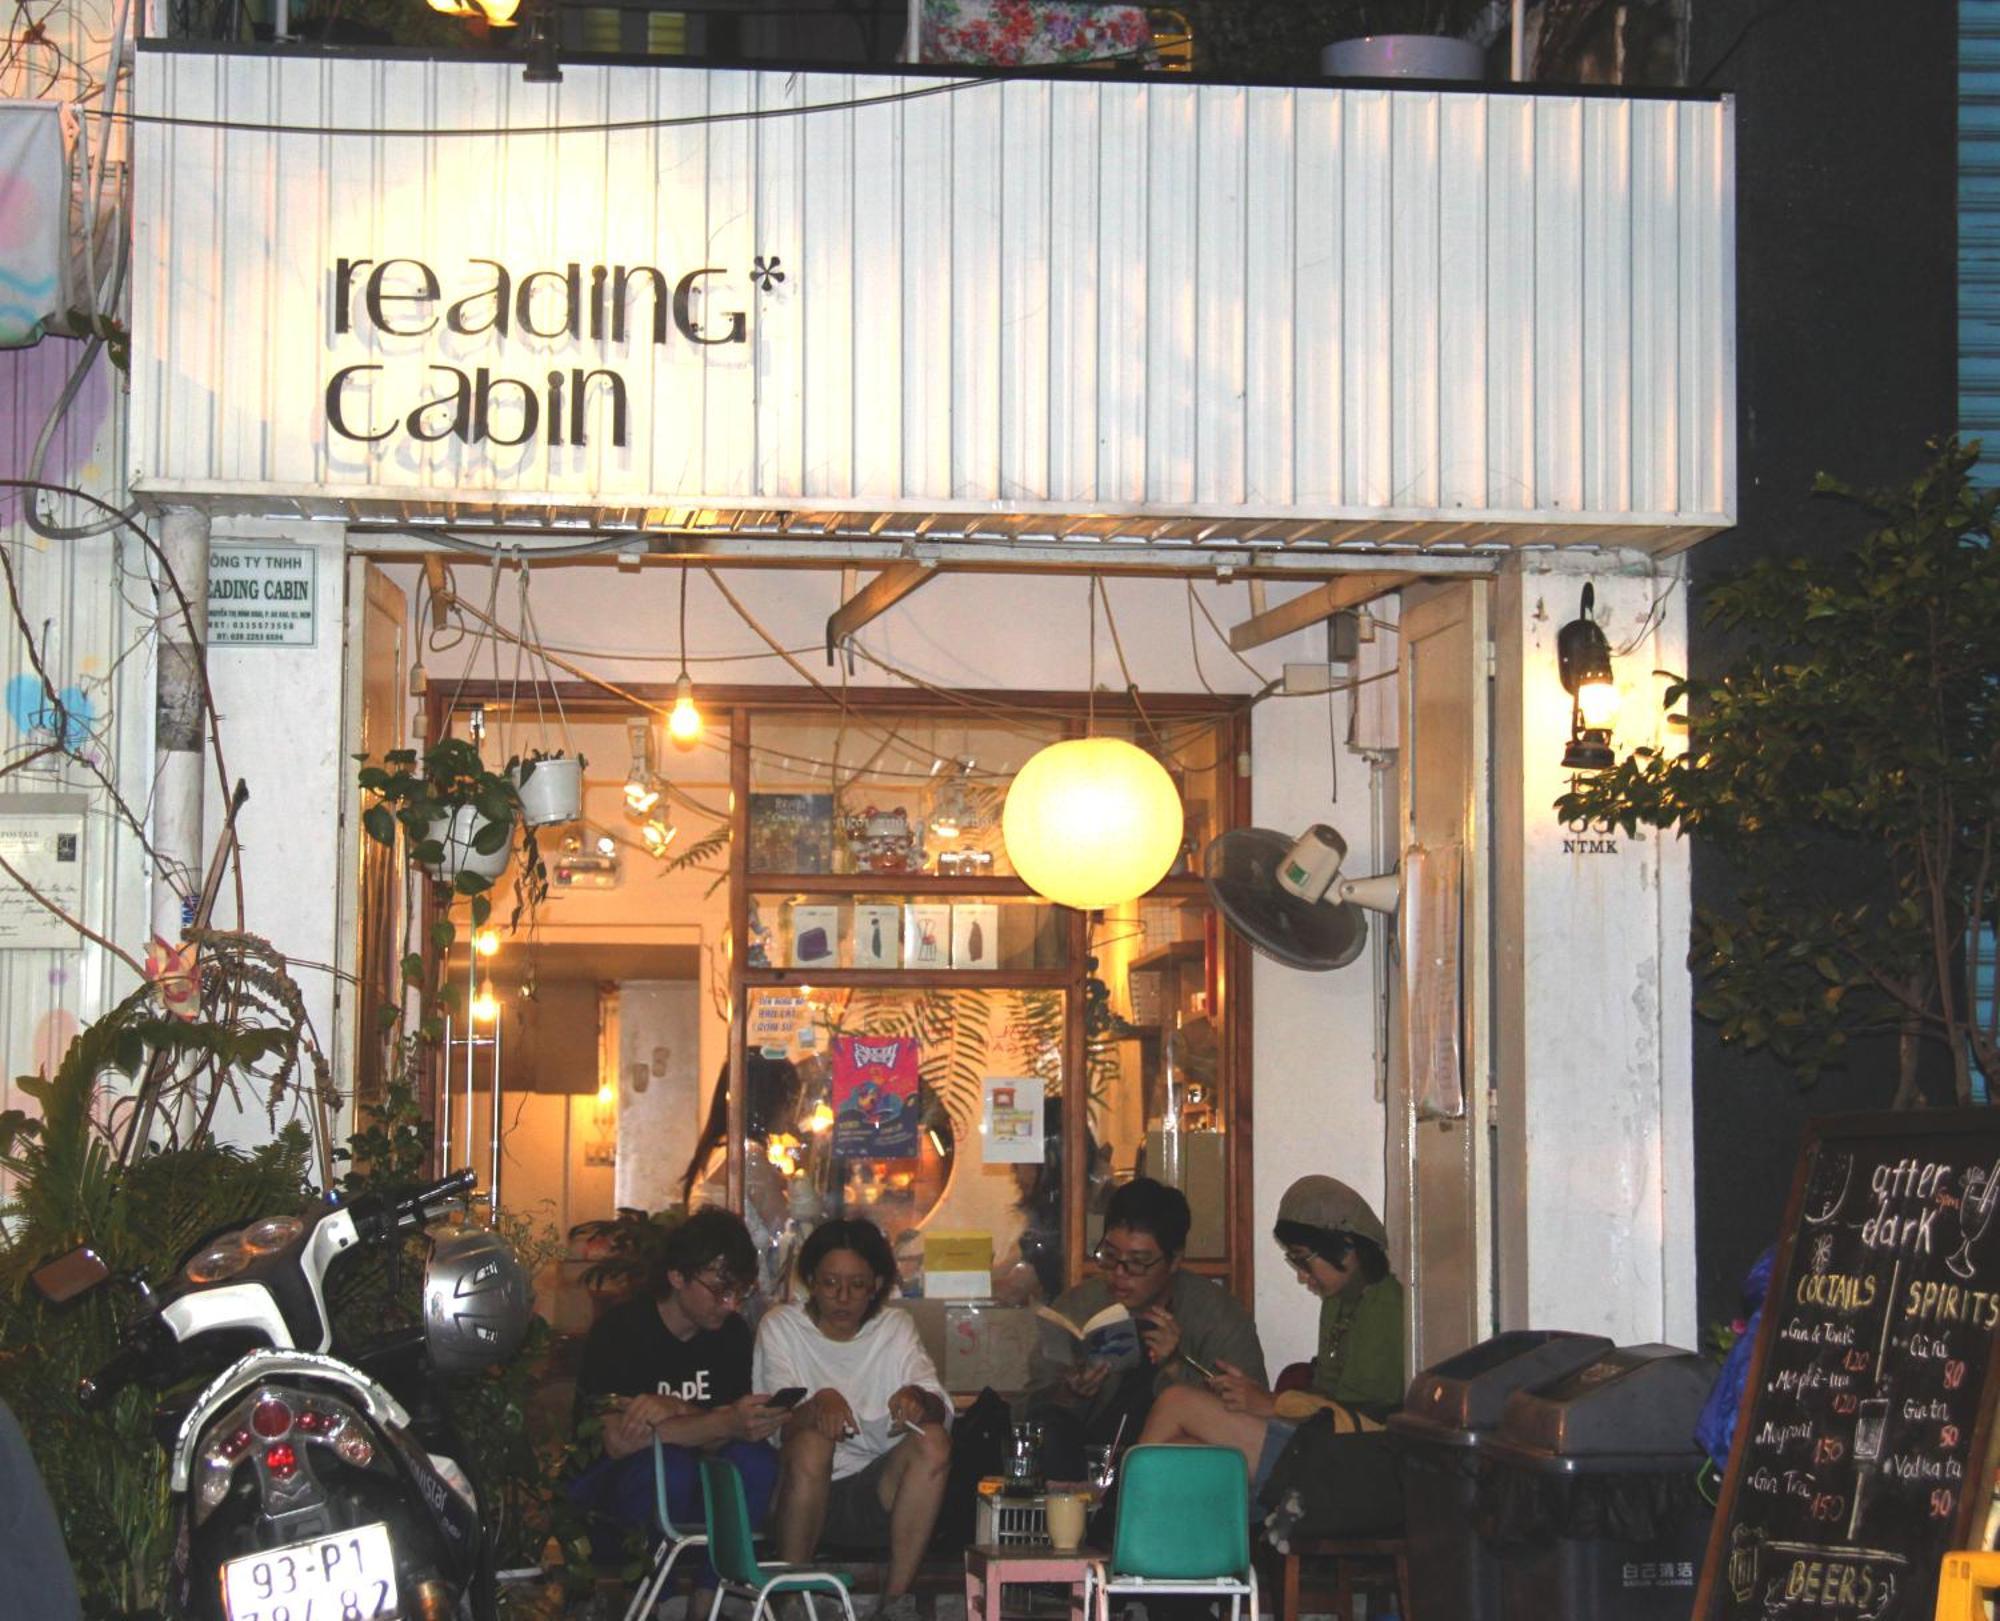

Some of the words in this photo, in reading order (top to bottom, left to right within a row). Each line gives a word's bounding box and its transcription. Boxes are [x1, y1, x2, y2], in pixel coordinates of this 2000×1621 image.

[209, 552, 240, 568] ÔNG
[244, 556, 261, 568] TY
[264, 557, 302, 569] TNHH
[208, 579, 259, 600] EADING
[264, 580, 308, 600] CABIN
[1563, 840, 1618, 854] NTMK
[1871, 1158, 1951, 1199] after
[1905, 1280, 2000, 1329] SPIRITS
[252, 1539, 364, 1600] 93-P1
[1785, 1560, 1873, 1609] BEERS
